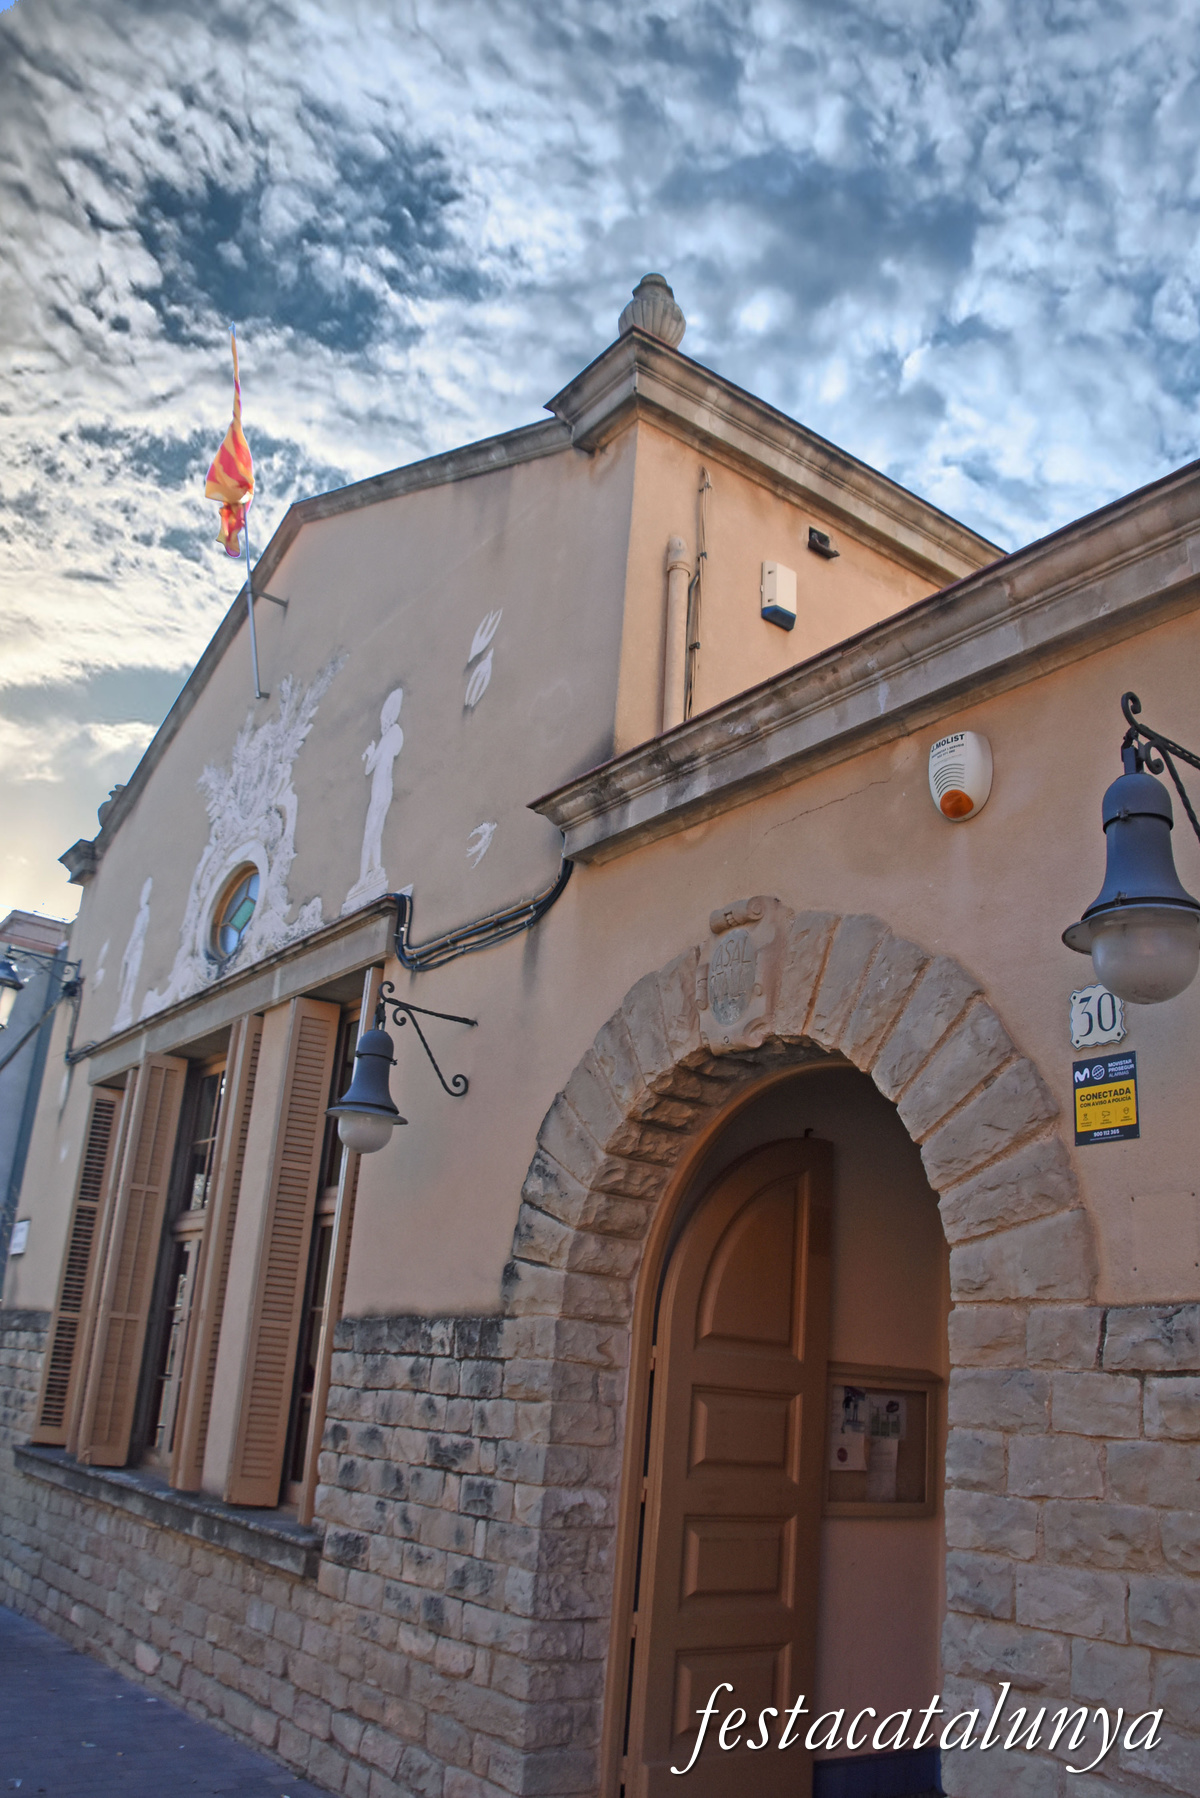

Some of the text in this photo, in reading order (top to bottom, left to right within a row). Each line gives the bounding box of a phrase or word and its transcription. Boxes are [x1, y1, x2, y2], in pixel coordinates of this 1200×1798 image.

[931, 734, 965, 752] J.MOLIST
[1079, 992, 1116, 1037] 30
[1108, 1059, 1132, 1067] MOVISTAR
[1108, 1064, 1135, 1072] PROSEGUR
[1108, 1070, 1130, 1078] ALARMAS
[1080, 1087, 1131, 1101] CONECTADA
[1112, 1095, 1132, 1103] POLICÍA
